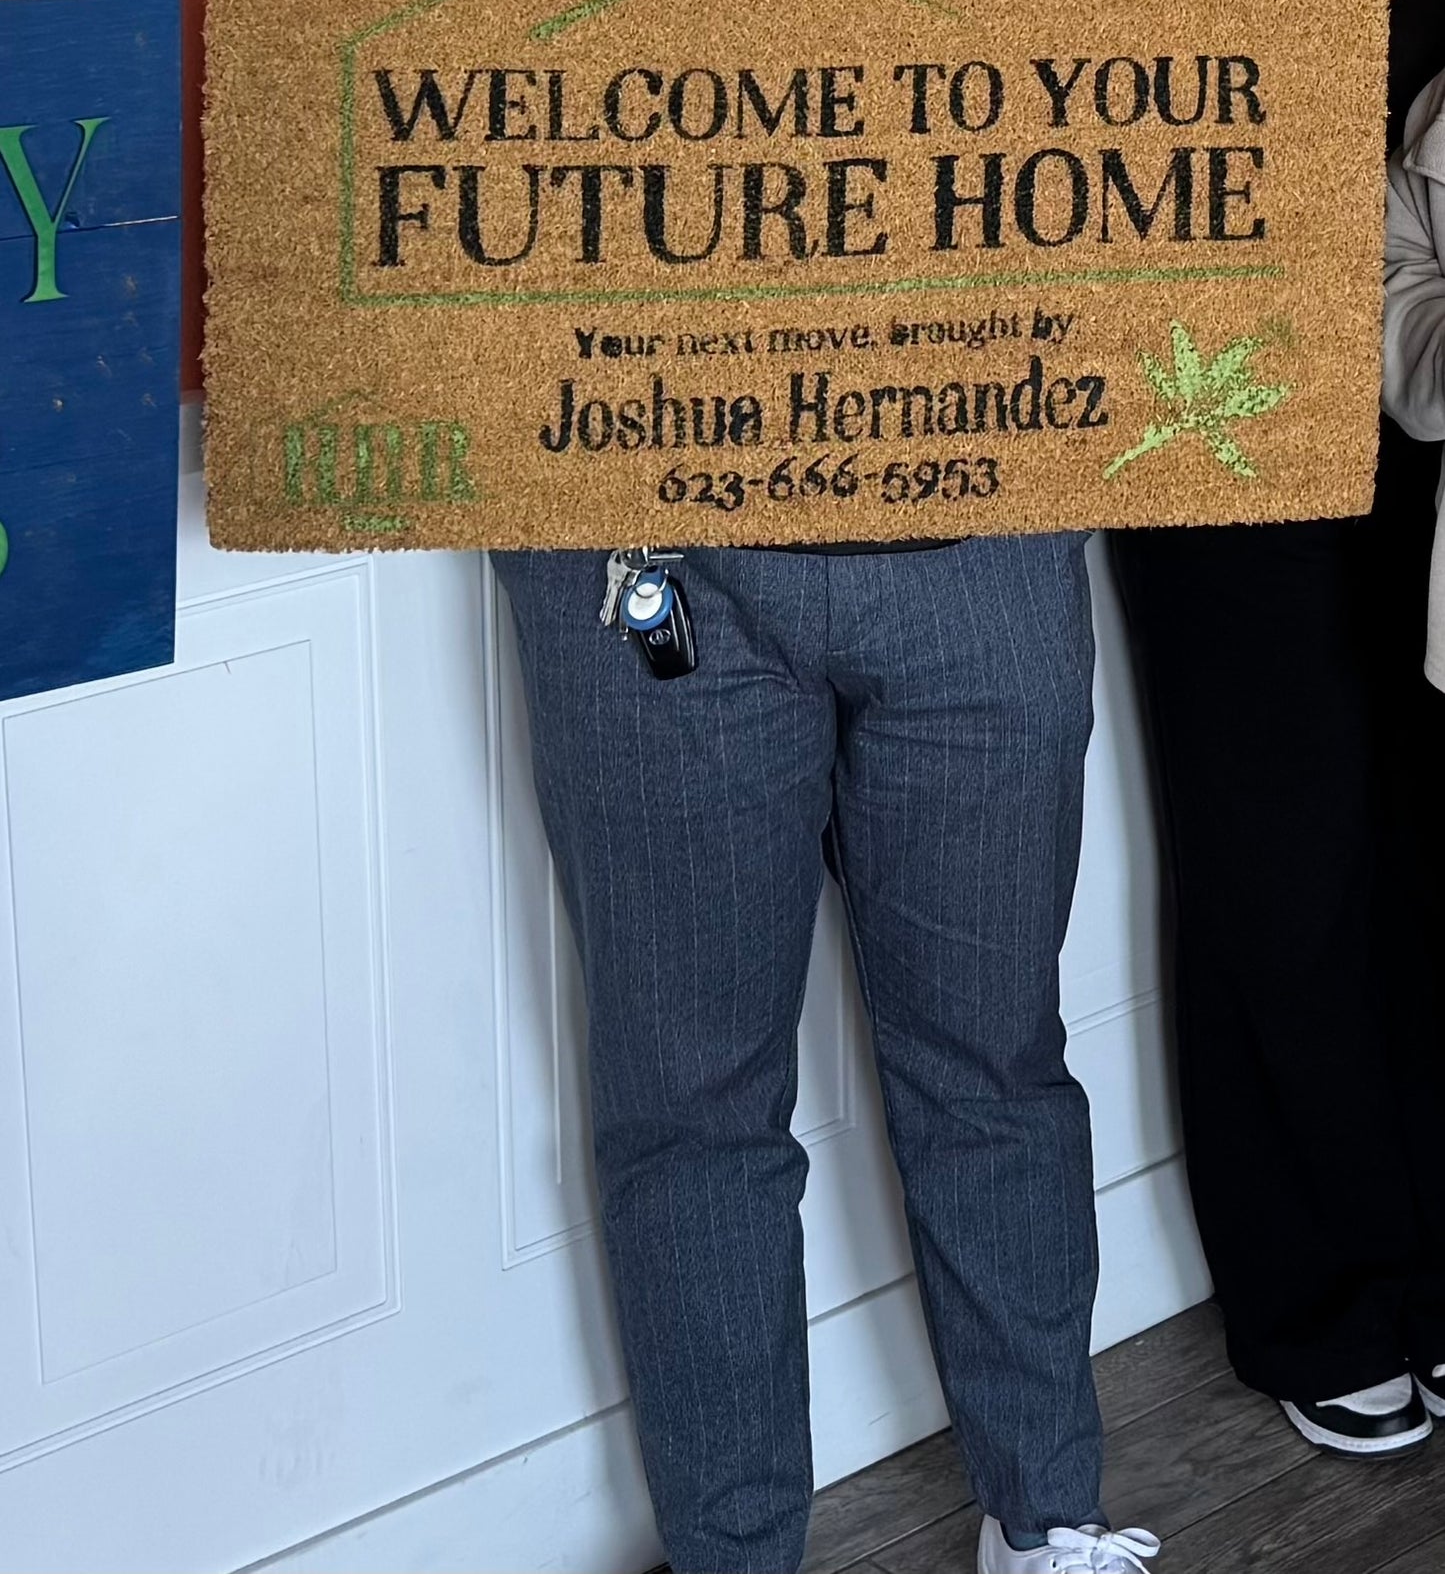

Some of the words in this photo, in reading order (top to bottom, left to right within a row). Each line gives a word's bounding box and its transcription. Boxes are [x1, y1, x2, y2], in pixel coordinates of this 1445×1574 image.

[370, 63, 866, 143] WELCOME
[893, 59, 1005, 136] TO
[1029, 54, 1268, 129] YOUR
[370, 157, 889, 269] FUTURE
[928, 145, 1268, 253] HOME
[574, 326, 665, 360] Your
[677, 330, 754, 356] next
[889, 308, 1023, 349] brought
[1031, 305, 1074, 344] by
[537, 372, 764, 453] Joshua
[789, 354, 1109, 444] Hernandez
